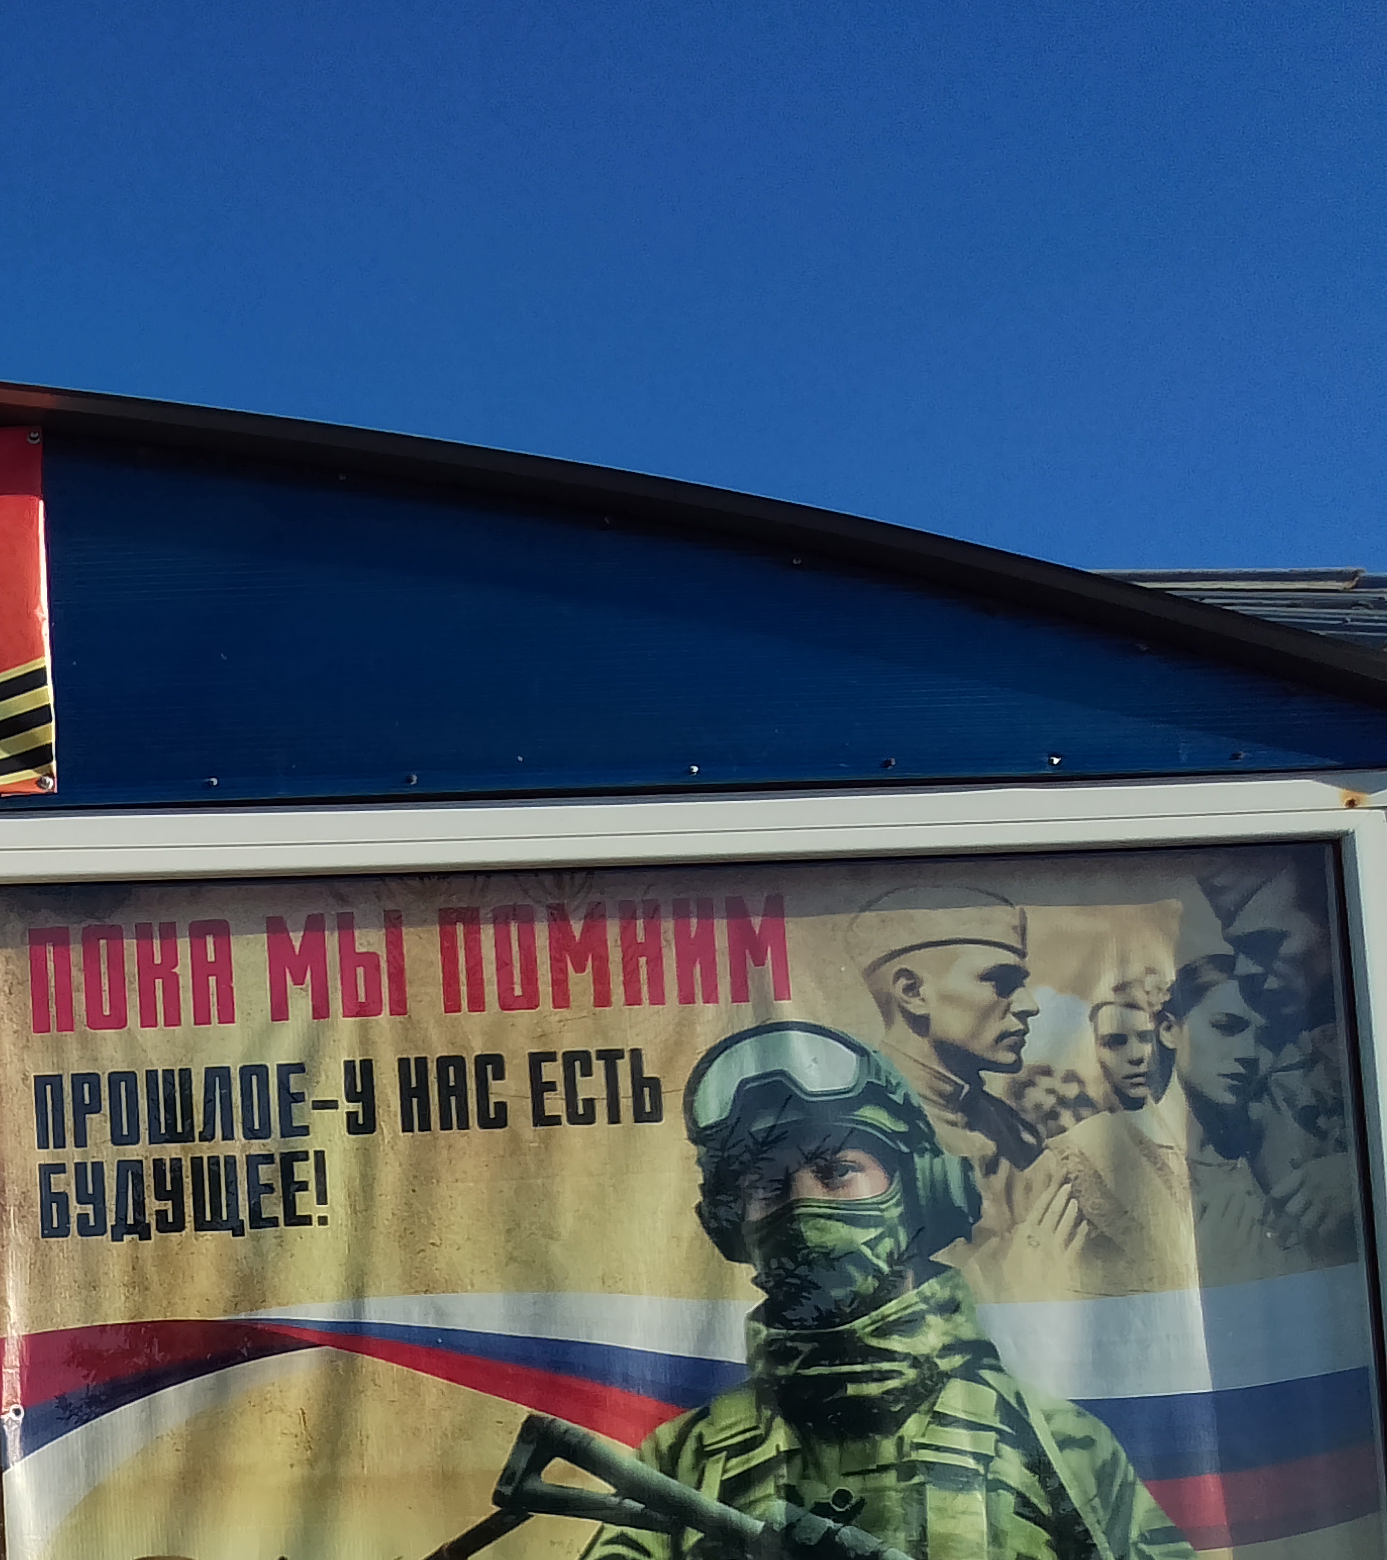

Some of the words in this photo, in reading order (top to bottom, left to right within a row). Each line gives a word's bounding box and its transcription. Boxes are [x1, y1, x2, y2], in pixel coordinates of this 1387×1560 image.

[27, 919, 236, 1035] ПОКА
[267, 908, 409, 1023] МЫ
[437, 894, 792, 1015] ПОМНИМ
[397, 1052, 508, 1134] НАС
[527, 1047, 665, 1128] ЕСТЬ
[38, 1149, 330, 1242] БУДУЩЕЕ!
